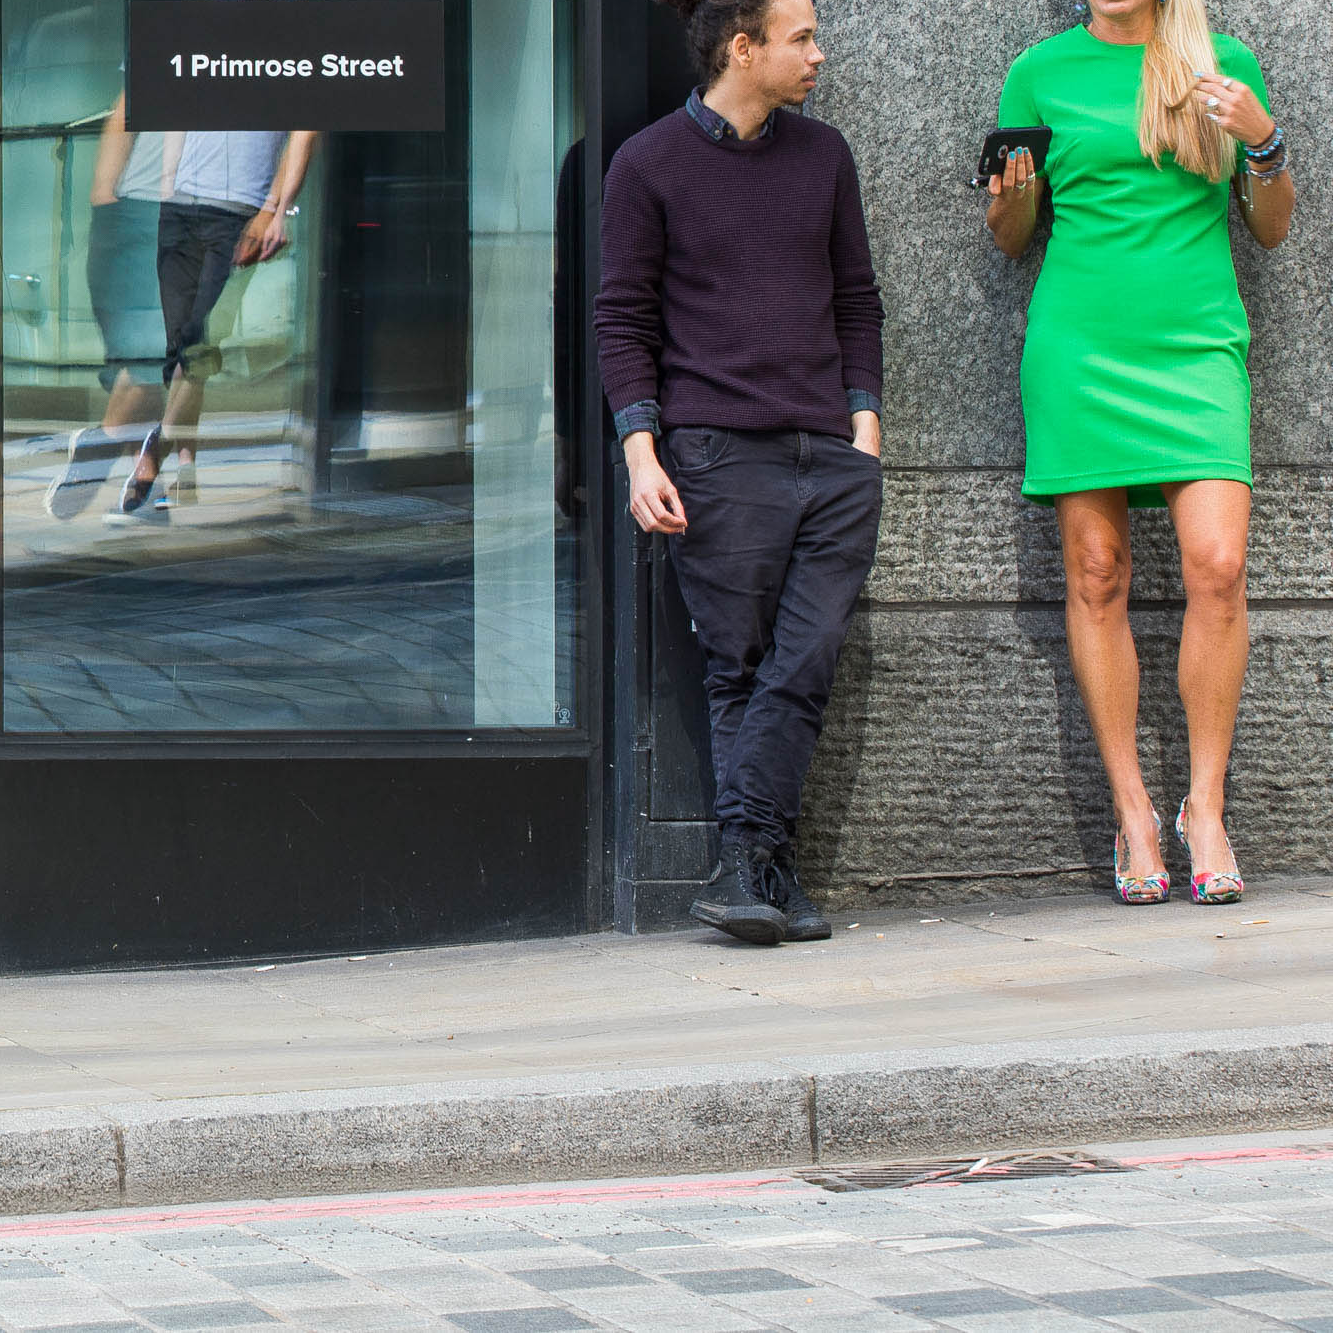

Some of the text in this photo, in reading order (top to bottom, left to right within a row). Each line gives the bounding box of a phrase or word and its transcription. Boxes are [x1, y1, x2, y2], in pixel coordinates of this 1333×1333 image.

[170, 53, 404, 78] 1 Primrose Street
